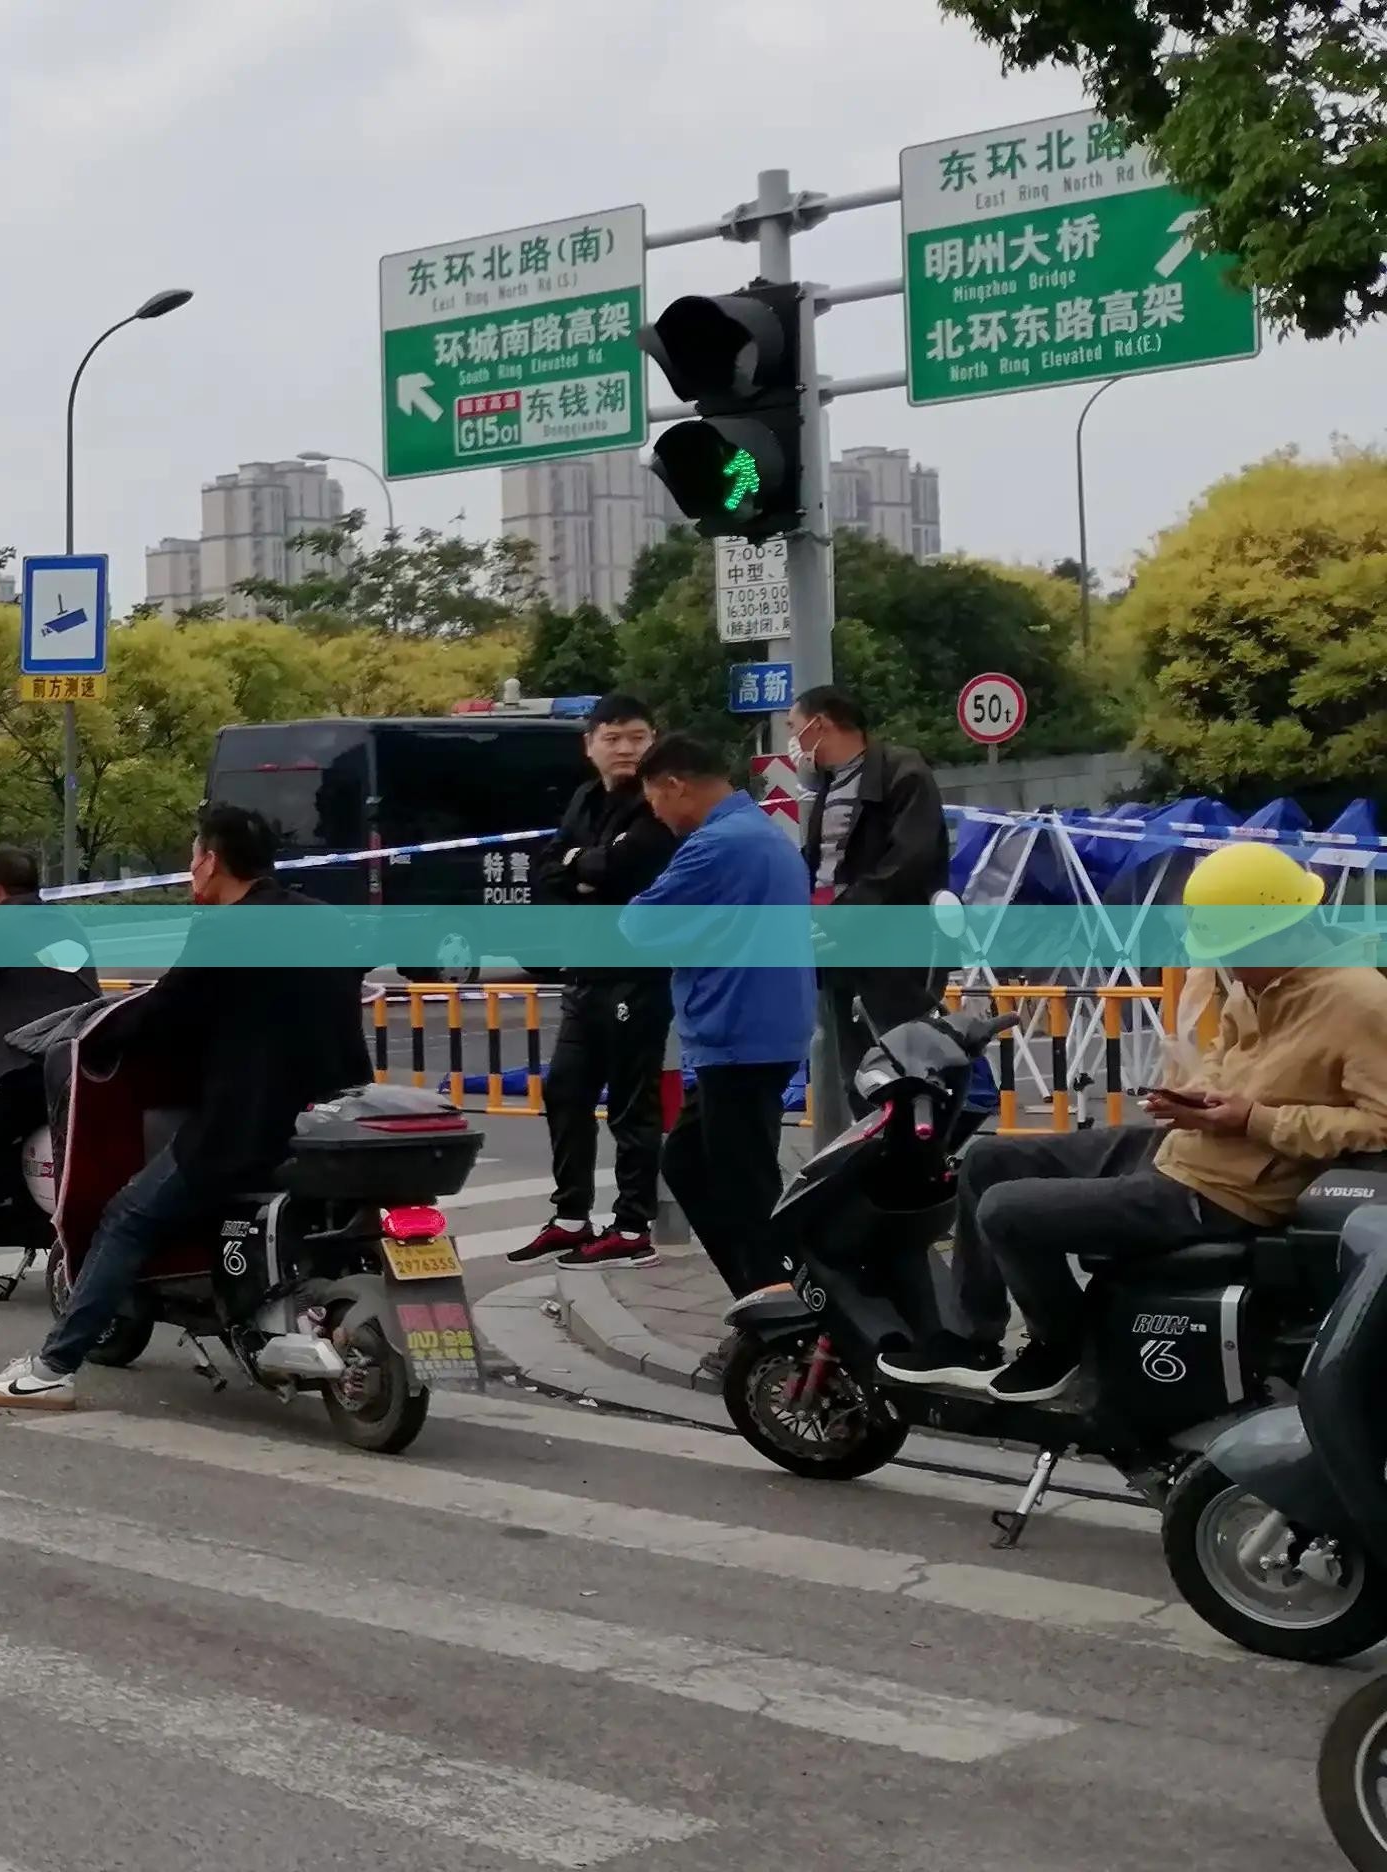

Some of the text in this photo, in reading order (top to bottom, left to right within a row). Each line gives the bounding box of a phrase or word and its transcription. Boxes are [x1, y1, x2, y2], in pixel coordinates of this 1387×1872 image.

[976, 190, 1006, 210] East
[1018, 184, 1049, 202] Ring
[1063, 170, 1103, 193] North
[407, 226, 615, 296] 东环北路(南)
[924, 213, 1102, 284] 明州大桥
[498, 282, 529, 300] North
[952, 267, 1077, 304] Mingzhou Bridge
[433, 301, 631, 368] 环城南路高架
[926, 282, 1186, 362] 北环东路高架
[458, 366, 490, 386] South
[497, 363, 523, 381] Ring
[531, 352, 579, 374] Elevated
[949, 360, 989, 383] North
[999, 357, 1031, 376] Ring
[1040, 344, 1103, 369] Elevated
[526, 378, 626, 424] 东钱湖
[459, 415, 519, 449] G1501
[31, 675, 97, 700] 前方测速
[738, 669, 788, 705] 高新
[483, 852, 531, 883] 特警
[483, 886, 532, 905] POLICE
[223, 1240, 247, 1276] 6
[1131, 1313, 1190, 1335] RUN
[1140, 1339, 1187, 1383] 6
